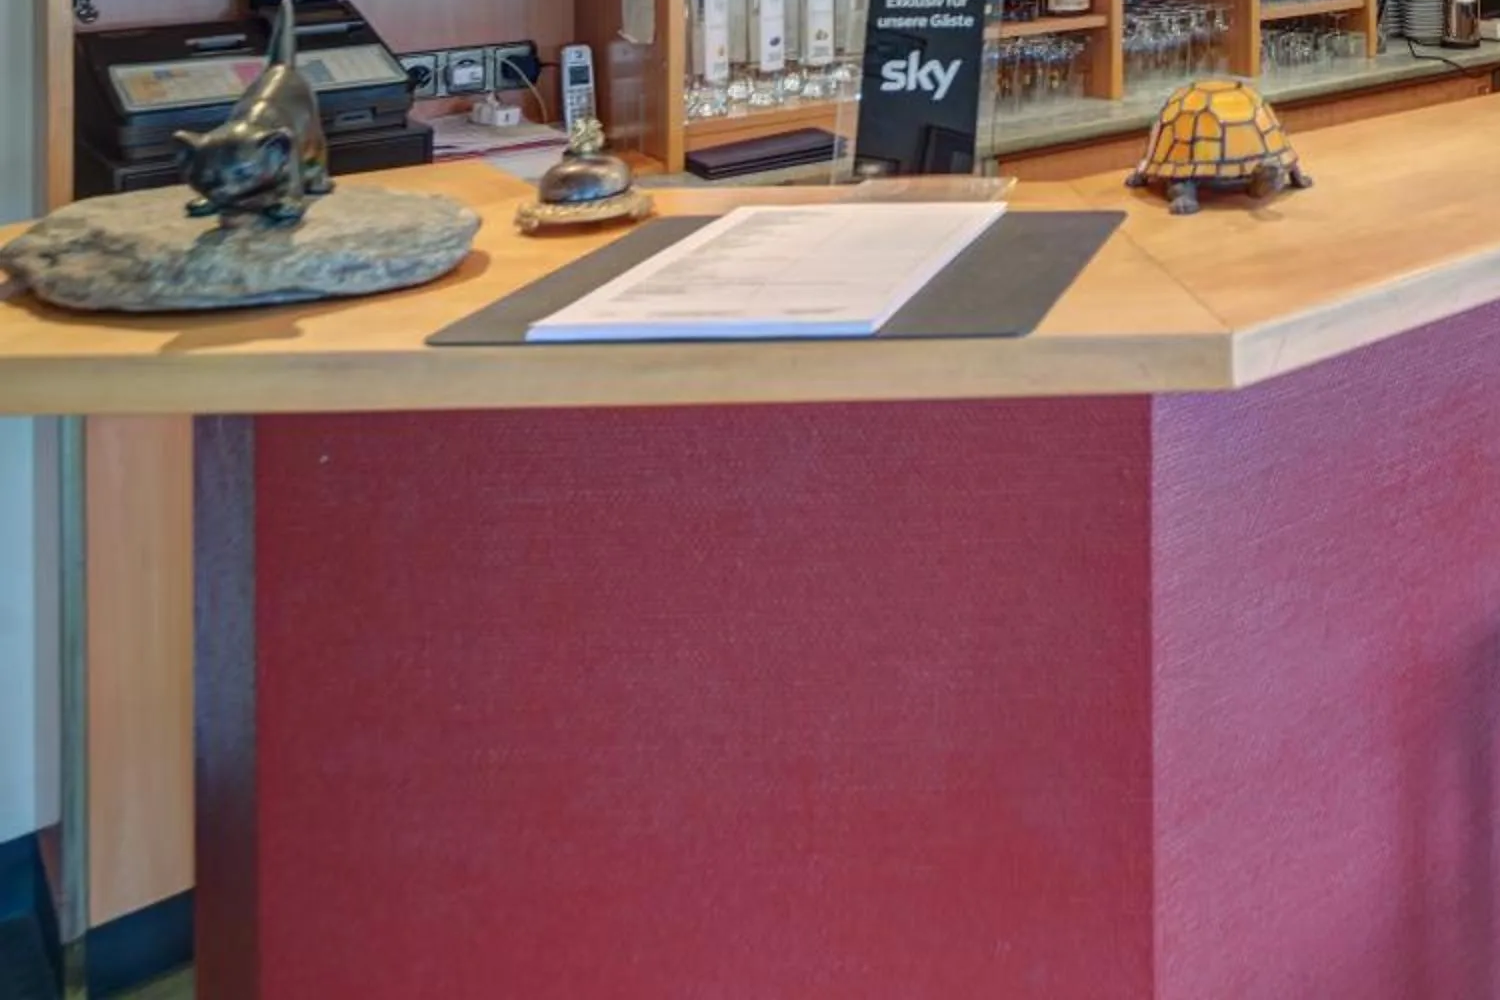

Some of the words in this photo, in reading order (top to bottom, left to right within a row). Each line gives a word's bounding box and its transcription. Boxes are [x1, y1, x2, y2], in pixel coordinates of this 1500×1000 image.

[877, 16, 928, 28] unsere
[929, 13, 974, 28] Gäste
[880, 49, 963, 101] sky
